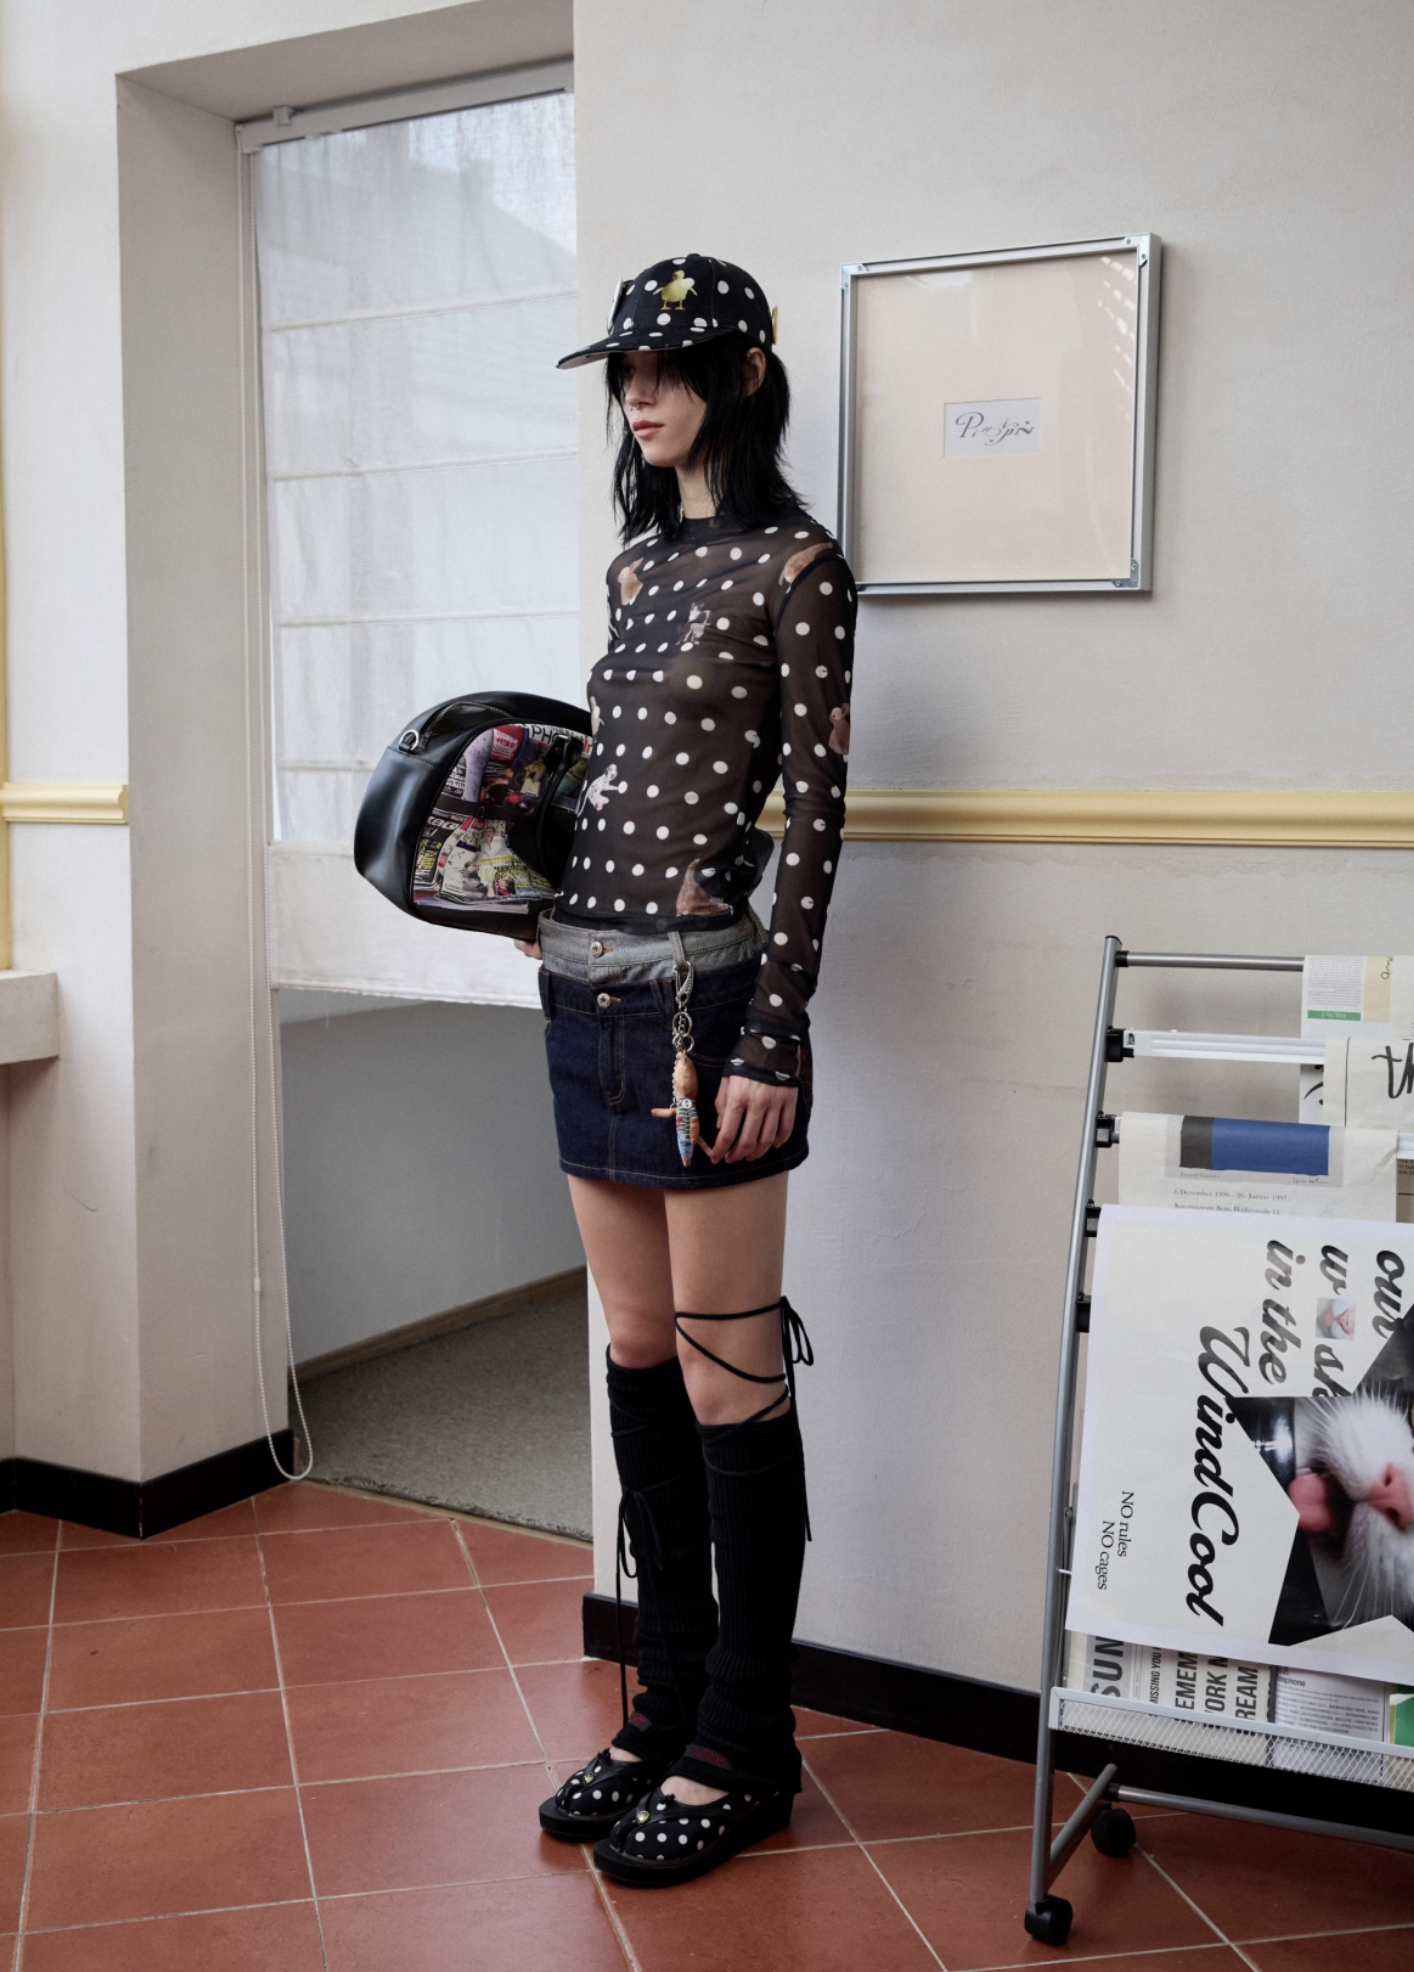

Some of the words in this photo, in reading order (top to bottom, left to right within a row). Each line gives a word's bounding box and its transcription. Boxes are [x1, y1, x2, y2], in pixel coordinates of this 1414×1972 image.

[1265, 1240, 1306, 1290] in
[1371, 1250, 1406, 1339] our
[1258, 1298, 1302, 1385] the
[1121, 1491, 1135, 1519] NO
[1100, 1520, 1115, 1548] NO
[1117, 1522, 1132, 1557] rules
[1095, 1551, 1110, 1590] cages
[1151, 1652, 1162, 1669] YOU
[1175, 1653, 1198, 1710] EMEM
[1204, 1671, 1227, 1713] ORK
[1235, 1667, 1258, 1720] REAM
